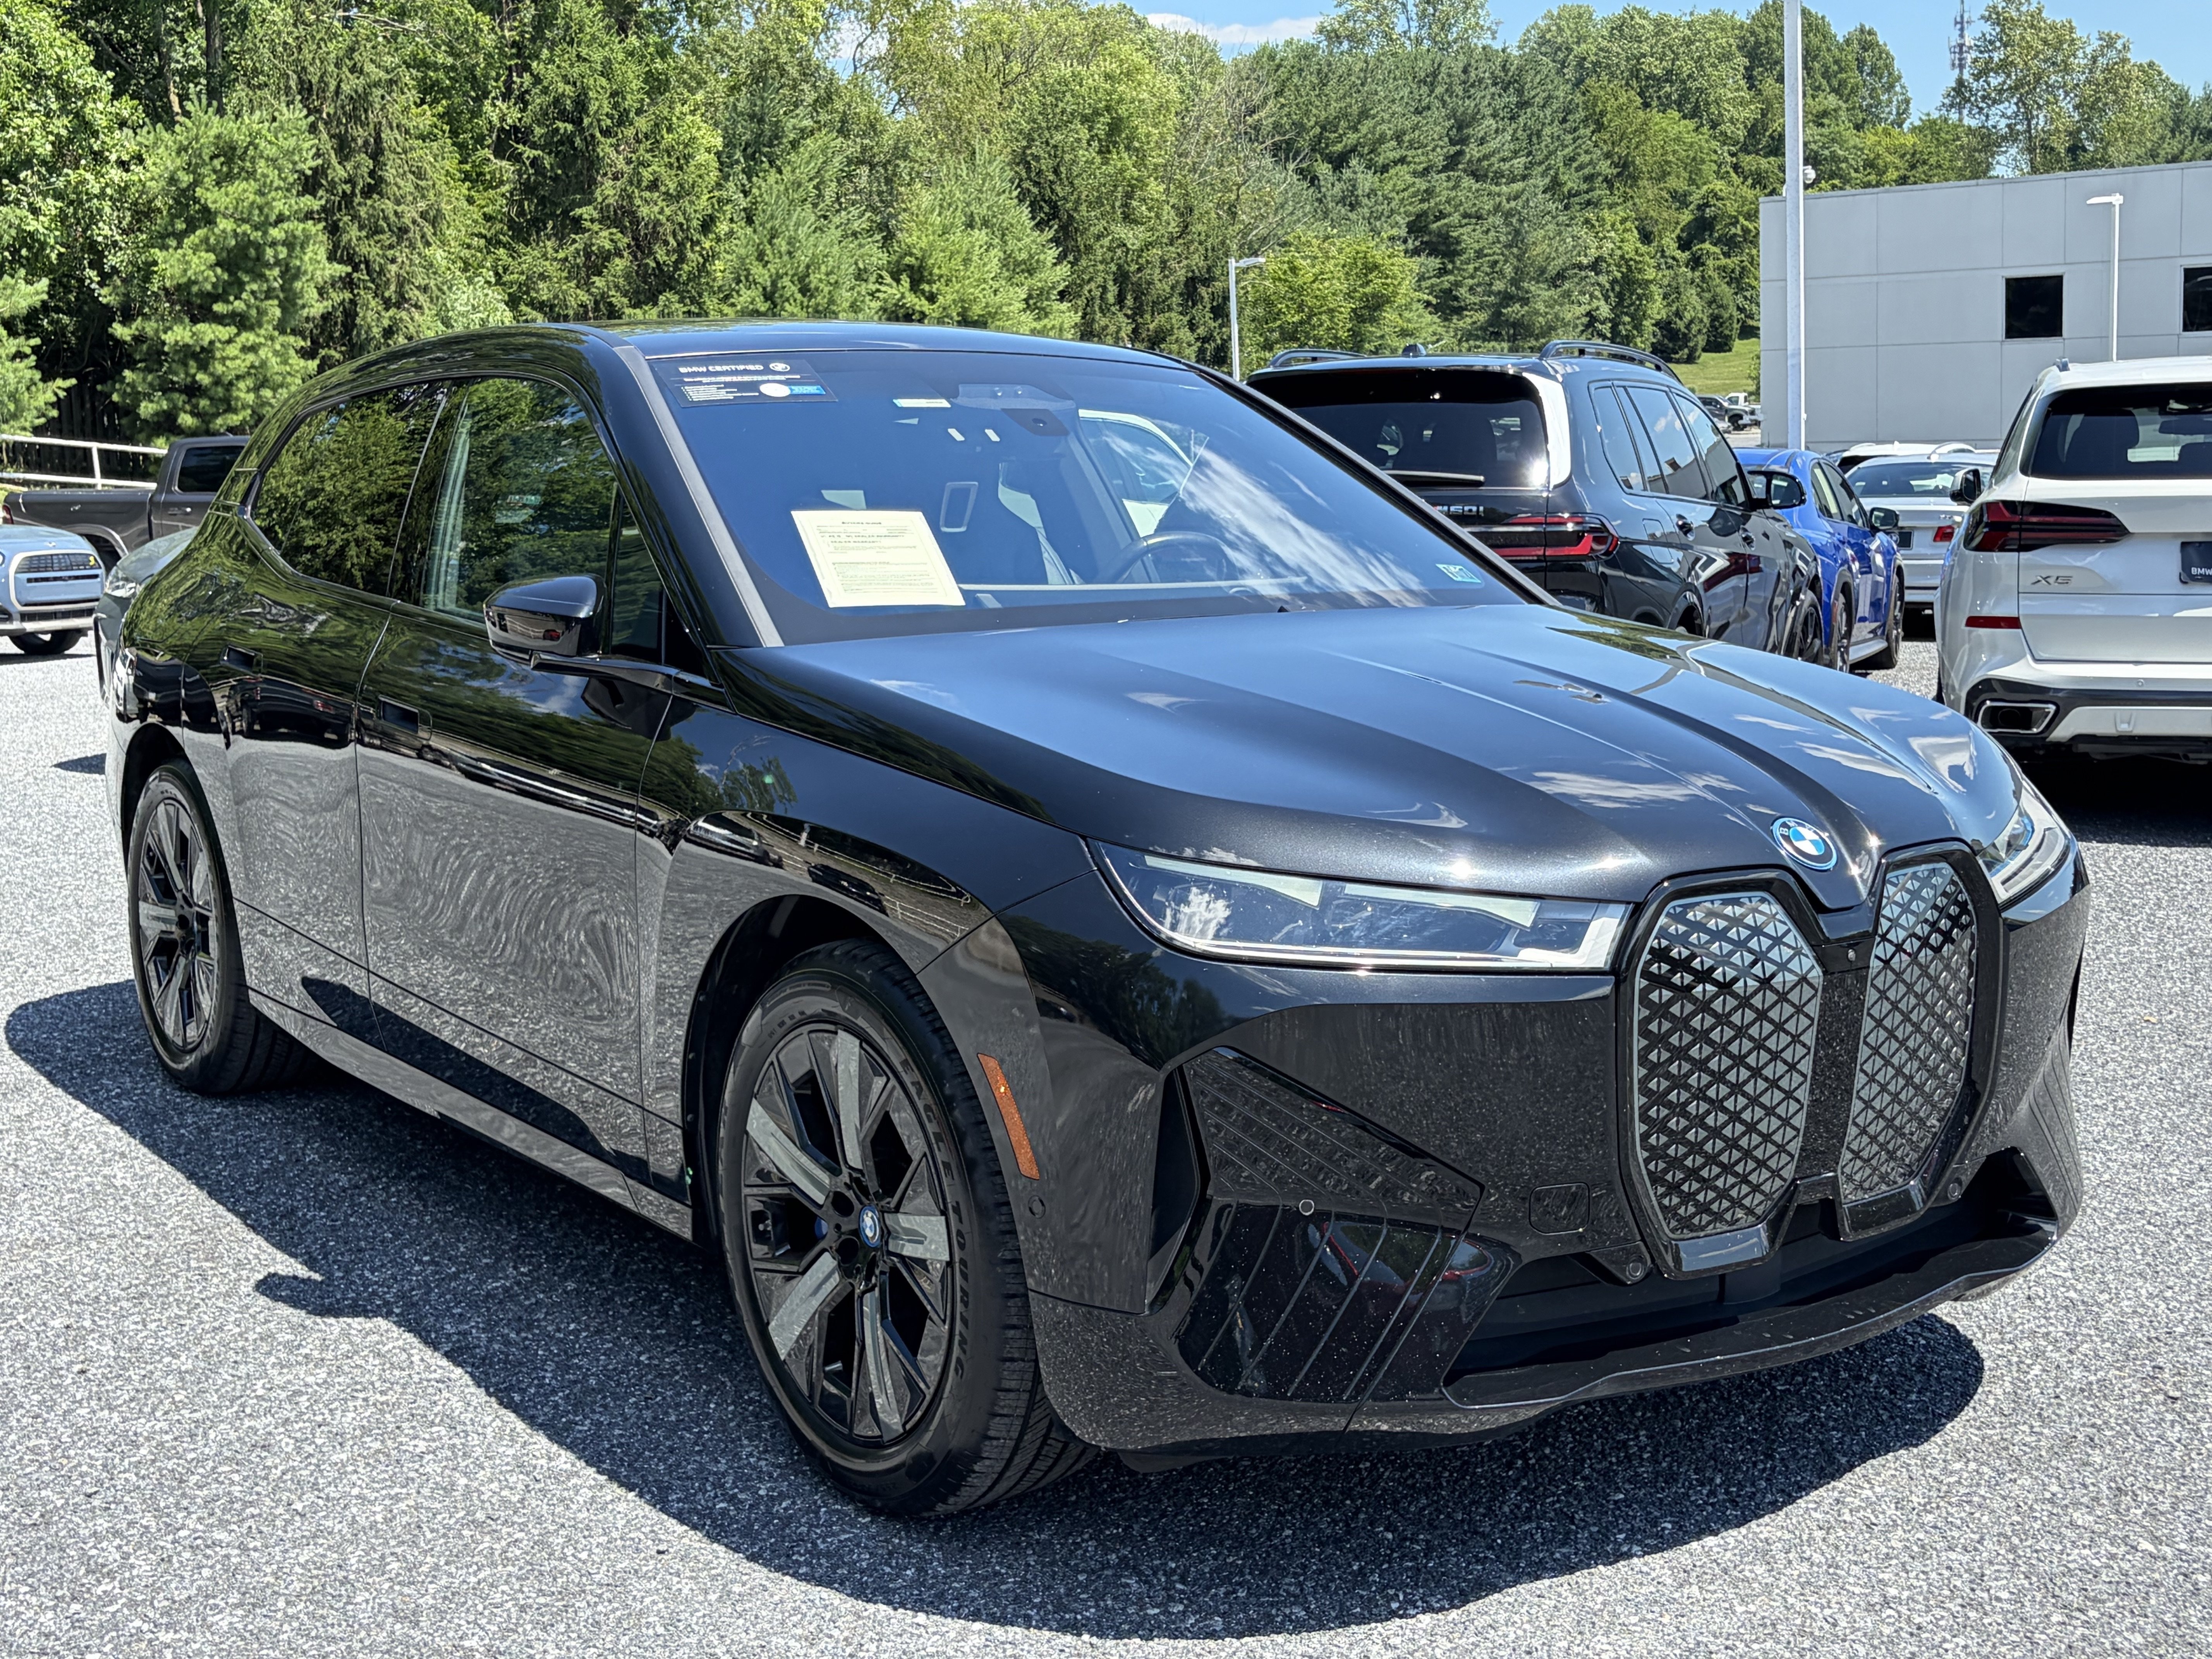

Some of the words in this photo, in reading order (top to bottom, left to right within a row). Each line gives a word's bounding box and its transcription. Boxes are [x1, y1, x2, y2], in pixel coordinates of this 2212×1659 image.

[2191, 567, 2212, 575] BMW
[899, 1058, 955, 1181] EAGLE
[951, 1201, 969, 1380] TOURING
